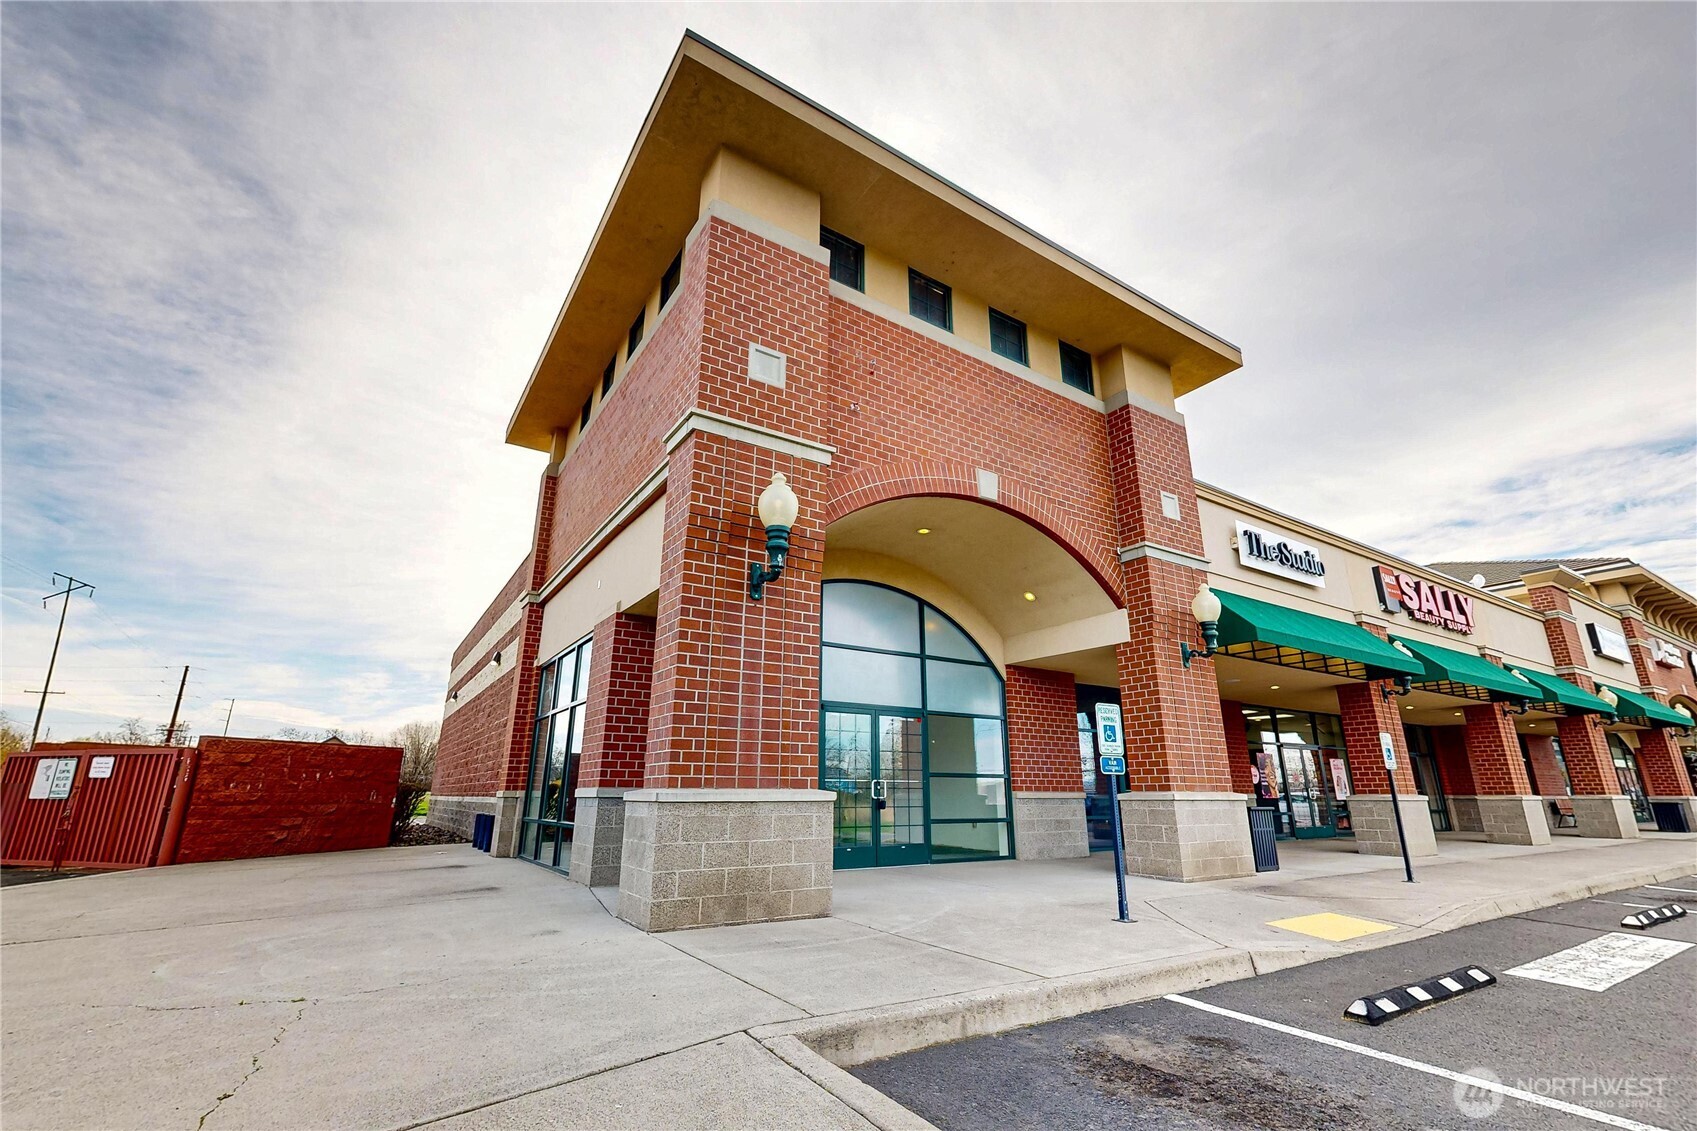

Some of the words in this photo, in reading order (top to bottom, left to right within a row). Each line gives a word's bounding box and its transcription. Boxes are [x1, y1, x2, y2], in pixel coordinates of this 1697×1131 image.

[1243, 529, 1280, 562] The
[1277, 541, 1326, 577] Studio
[1396, 573, 1475, 627] SALLY
[1409, 609, 1445, 627] BEAUTY
[1445, 619, 1474, 635] SUPPLY
